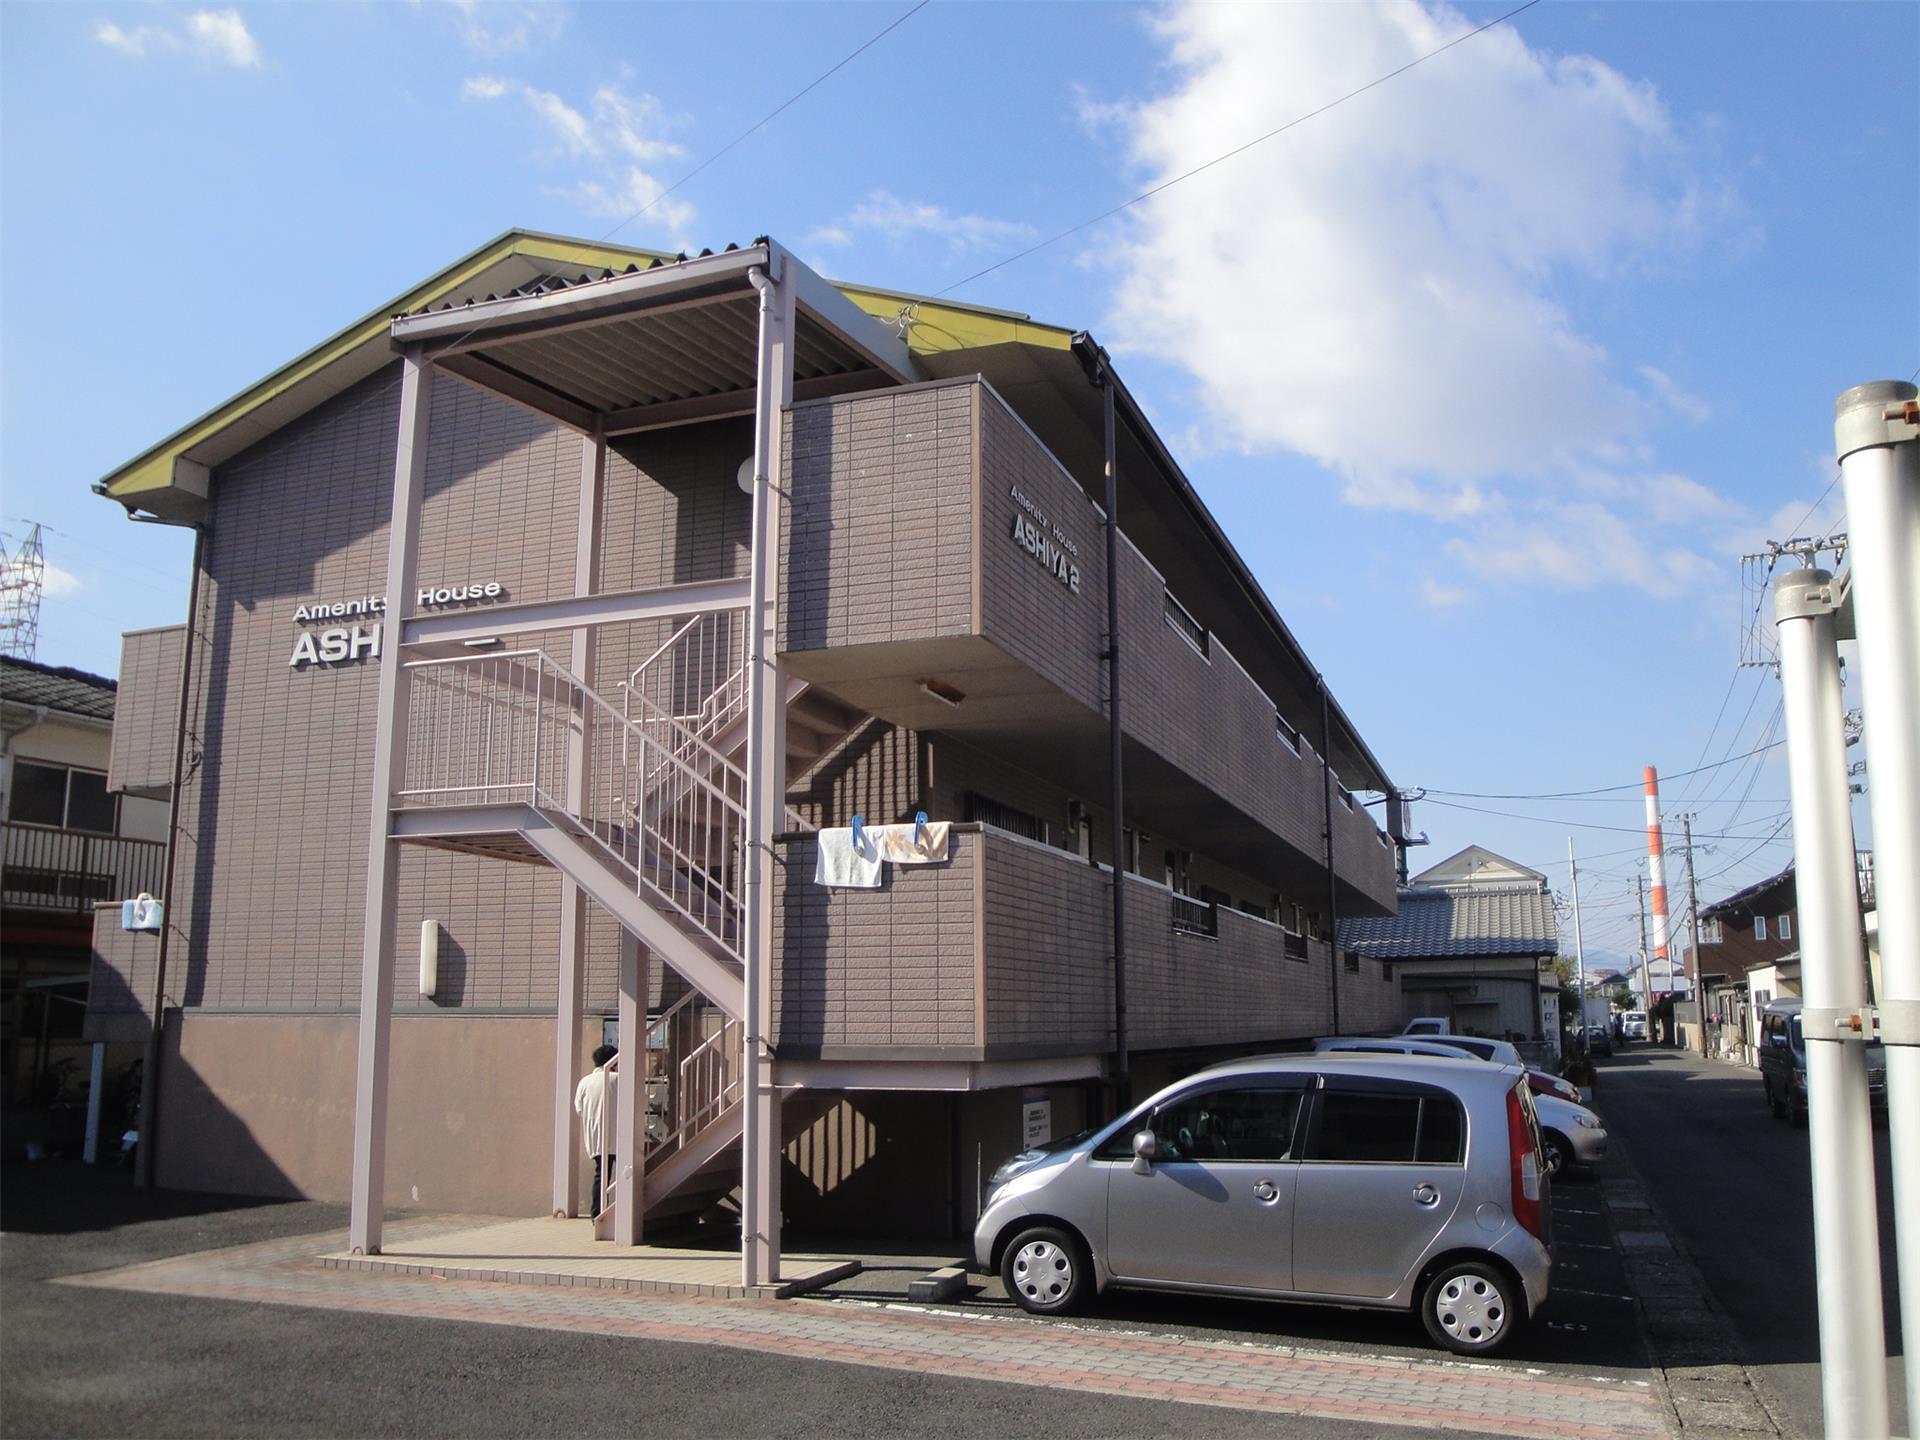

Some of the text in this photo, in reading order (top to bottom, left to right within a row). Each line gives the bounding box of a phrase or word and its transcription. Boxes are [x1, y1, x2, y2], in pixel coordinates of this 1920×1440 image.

[1010, 484, 1078, 556] Amenity House
[417, 581, 501, 606] House
